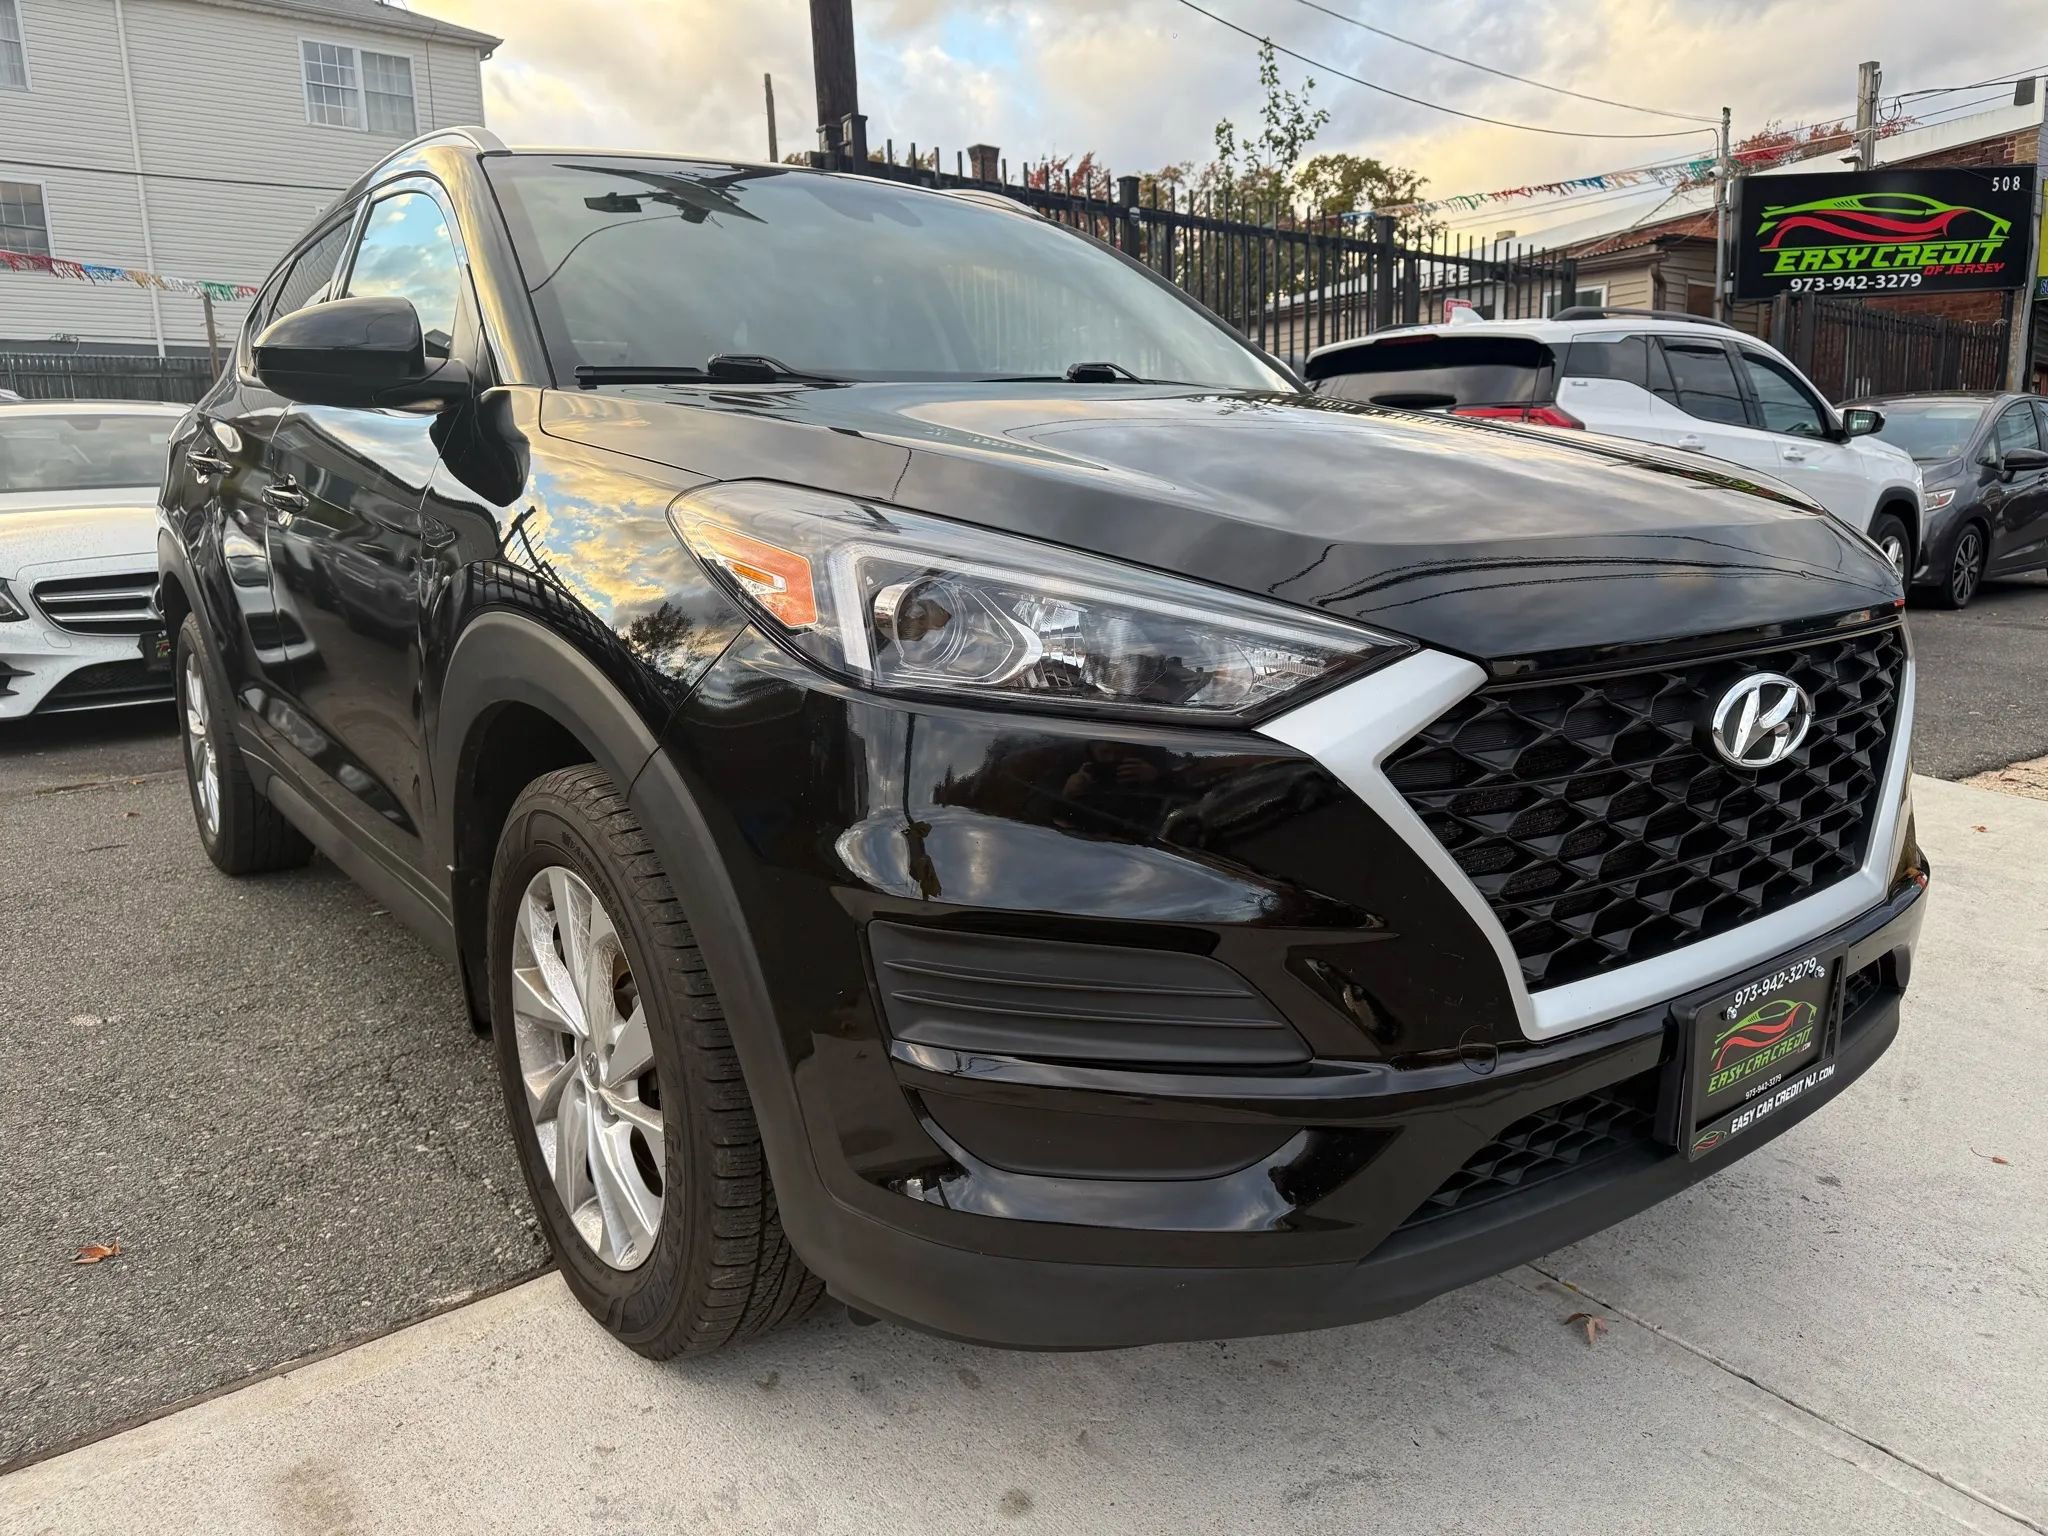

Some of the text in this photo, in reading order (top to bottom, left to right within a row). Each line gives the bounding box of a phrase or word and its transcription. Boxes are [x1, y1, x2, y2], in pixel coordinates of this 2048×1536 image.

[1992, 176, 2020, 191] 508
[1774, 240, 2004, 272] EASY CREDIT
[1923, 262, 2005, 276] OF JERSEY
[1790, 273, 1921, 292] 973-942-3279
[1734, 957, 1817, 1009] 973-942-3279
[1708, 1027, 1813, 1093] EASY CAR CREDIT
[1745, 1074, 1782, 1100] 973-942-3279
[1731, 1108, 1756, 1133] EASY
[1756, 1097, 1774, 1118] CAR
[1775, 1078, 1805, 1107] CREDIT
